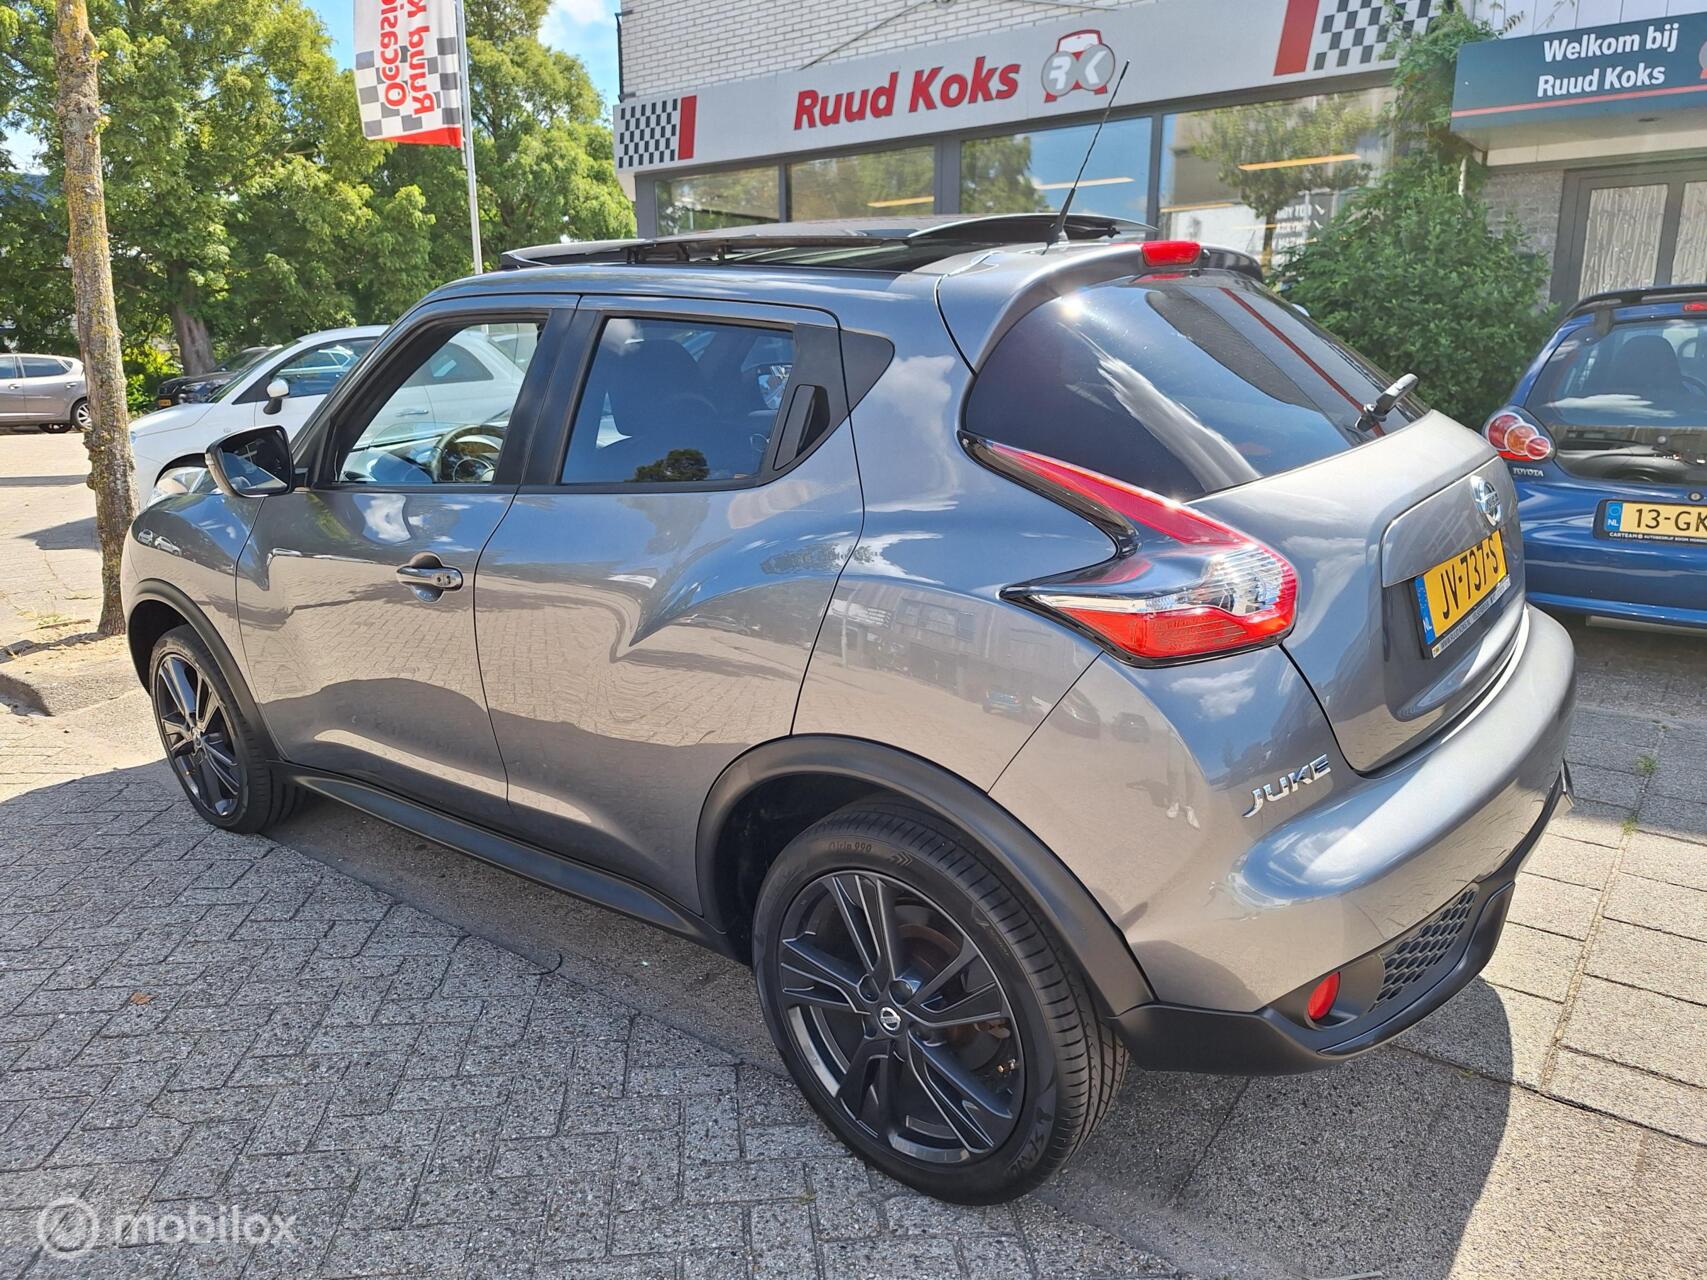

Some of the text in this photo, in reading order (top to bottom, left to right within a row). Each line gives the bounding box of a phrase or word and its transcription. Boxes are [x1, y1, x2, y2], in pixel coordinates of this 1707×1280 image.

[1543, 23, 1679, 63] Welkom bij
[794, 56, 1021, 130] Ruud Koks
[1537, 63, 1666, 97] Ruud Koks
[1512, 467, 1544, 477] TOYOTA
[1607, 518, 1620, 527] NL
[1440, 535, 1498, 620] JV-737-S
[1242, 753, 1331, 818] JUKE
